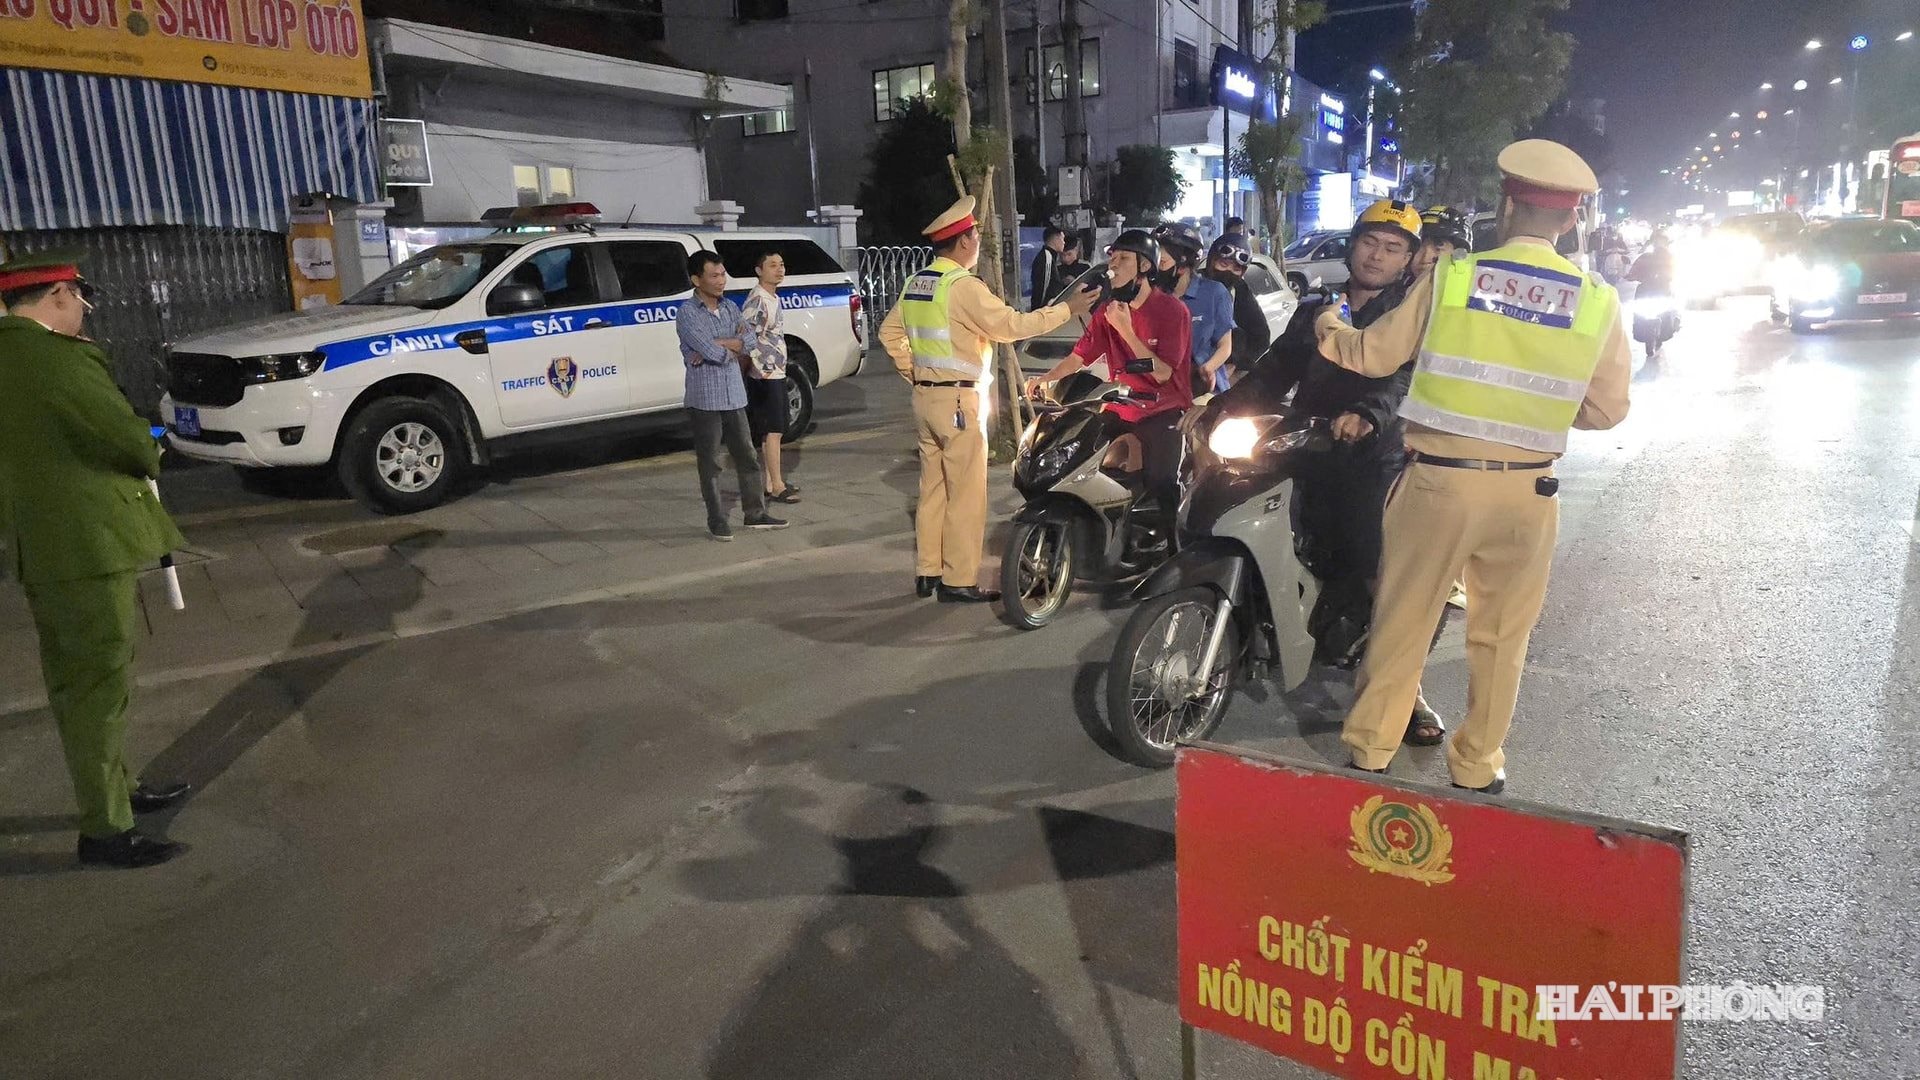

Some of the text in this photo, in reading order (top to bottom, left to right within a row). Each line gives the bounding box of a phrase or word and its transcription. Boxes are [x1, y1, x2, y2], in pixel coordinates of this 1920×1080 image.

[368, 334, 444, 357] CẢNH
[531, 316, 573, 336] SÁT
[780, 293, 823, 309] HÔNG
[501, 365, 617, 392] TRAFFIC POLICE
[1198, 958, 1292, 1036] NỒNG
[1304, 997, 1352, 1064] ĐỘ
[1259, 914, 1558, 1048] CHỐT KIỂM TRA
